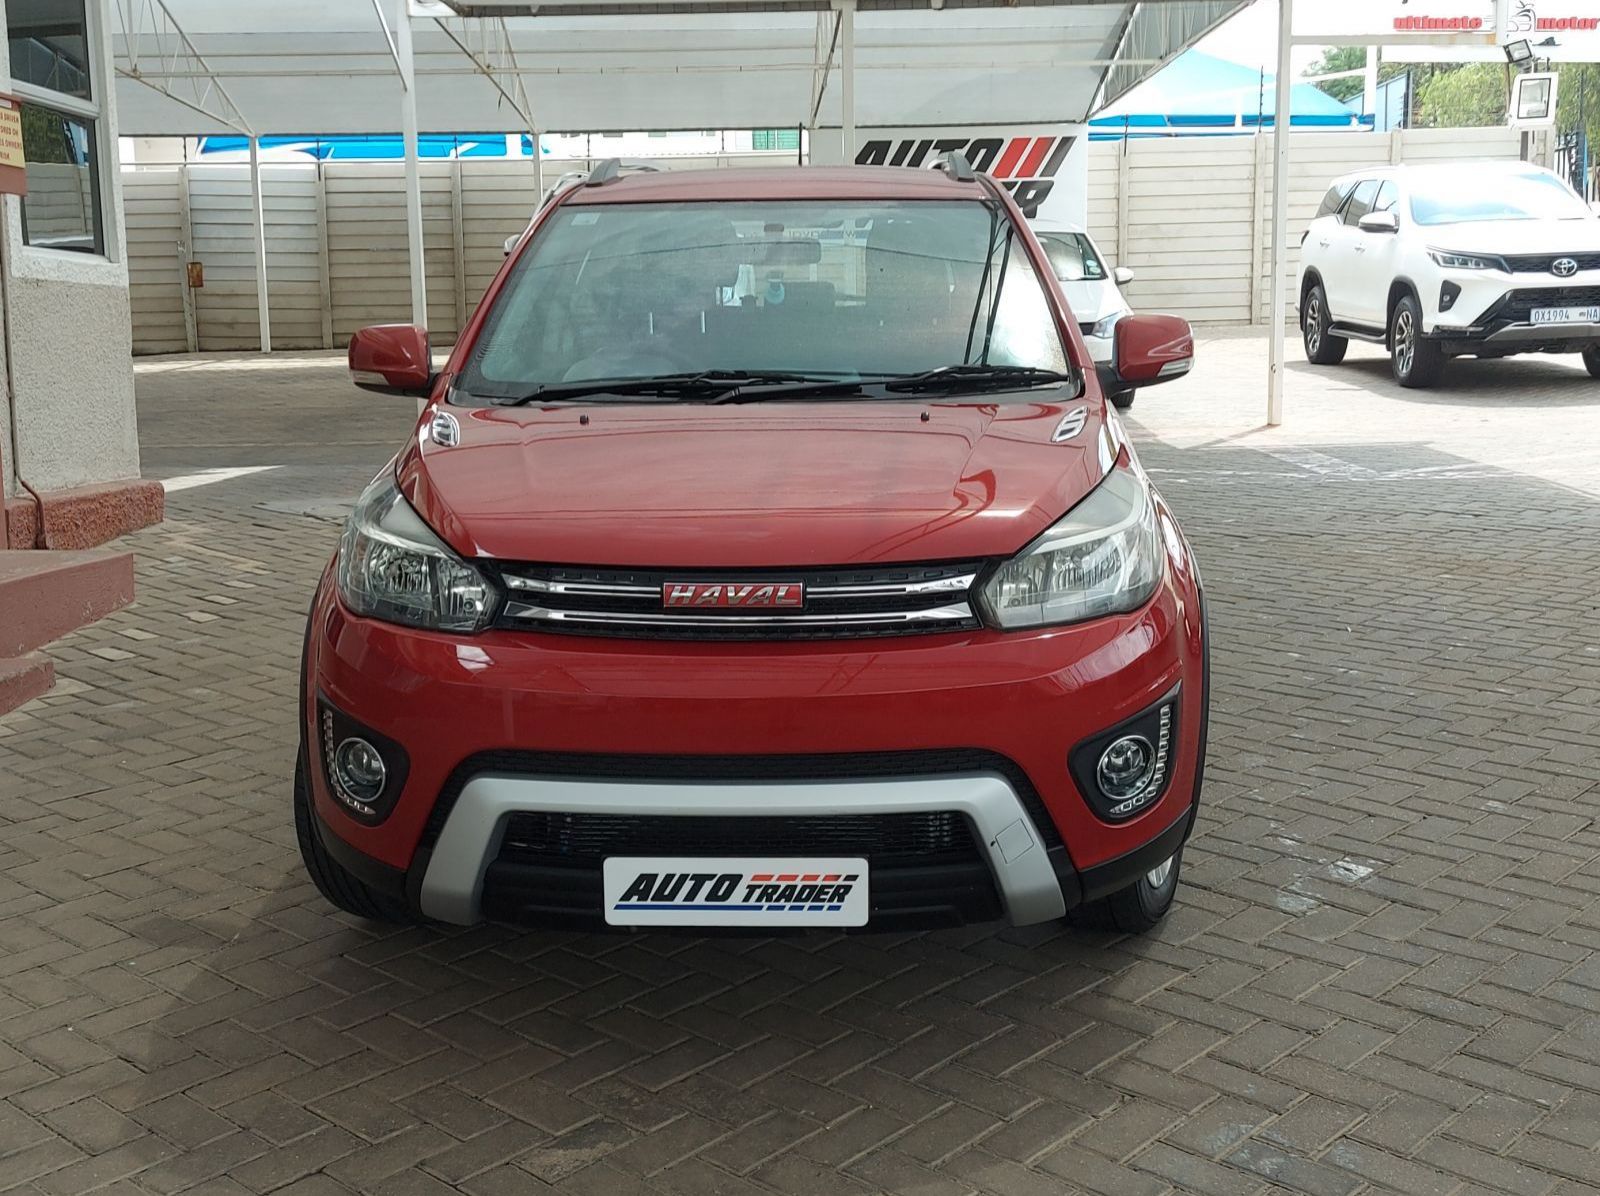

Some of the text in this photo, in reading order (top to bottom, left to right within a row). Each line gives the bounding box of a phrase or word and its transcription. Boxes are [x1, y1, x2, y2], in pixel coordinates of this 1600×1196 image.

[1393, 15, 1483, 30] ultimate
[668, 585, 799, 606] HAVAL
[618, 873, 853, 904] AUTO TRADER
